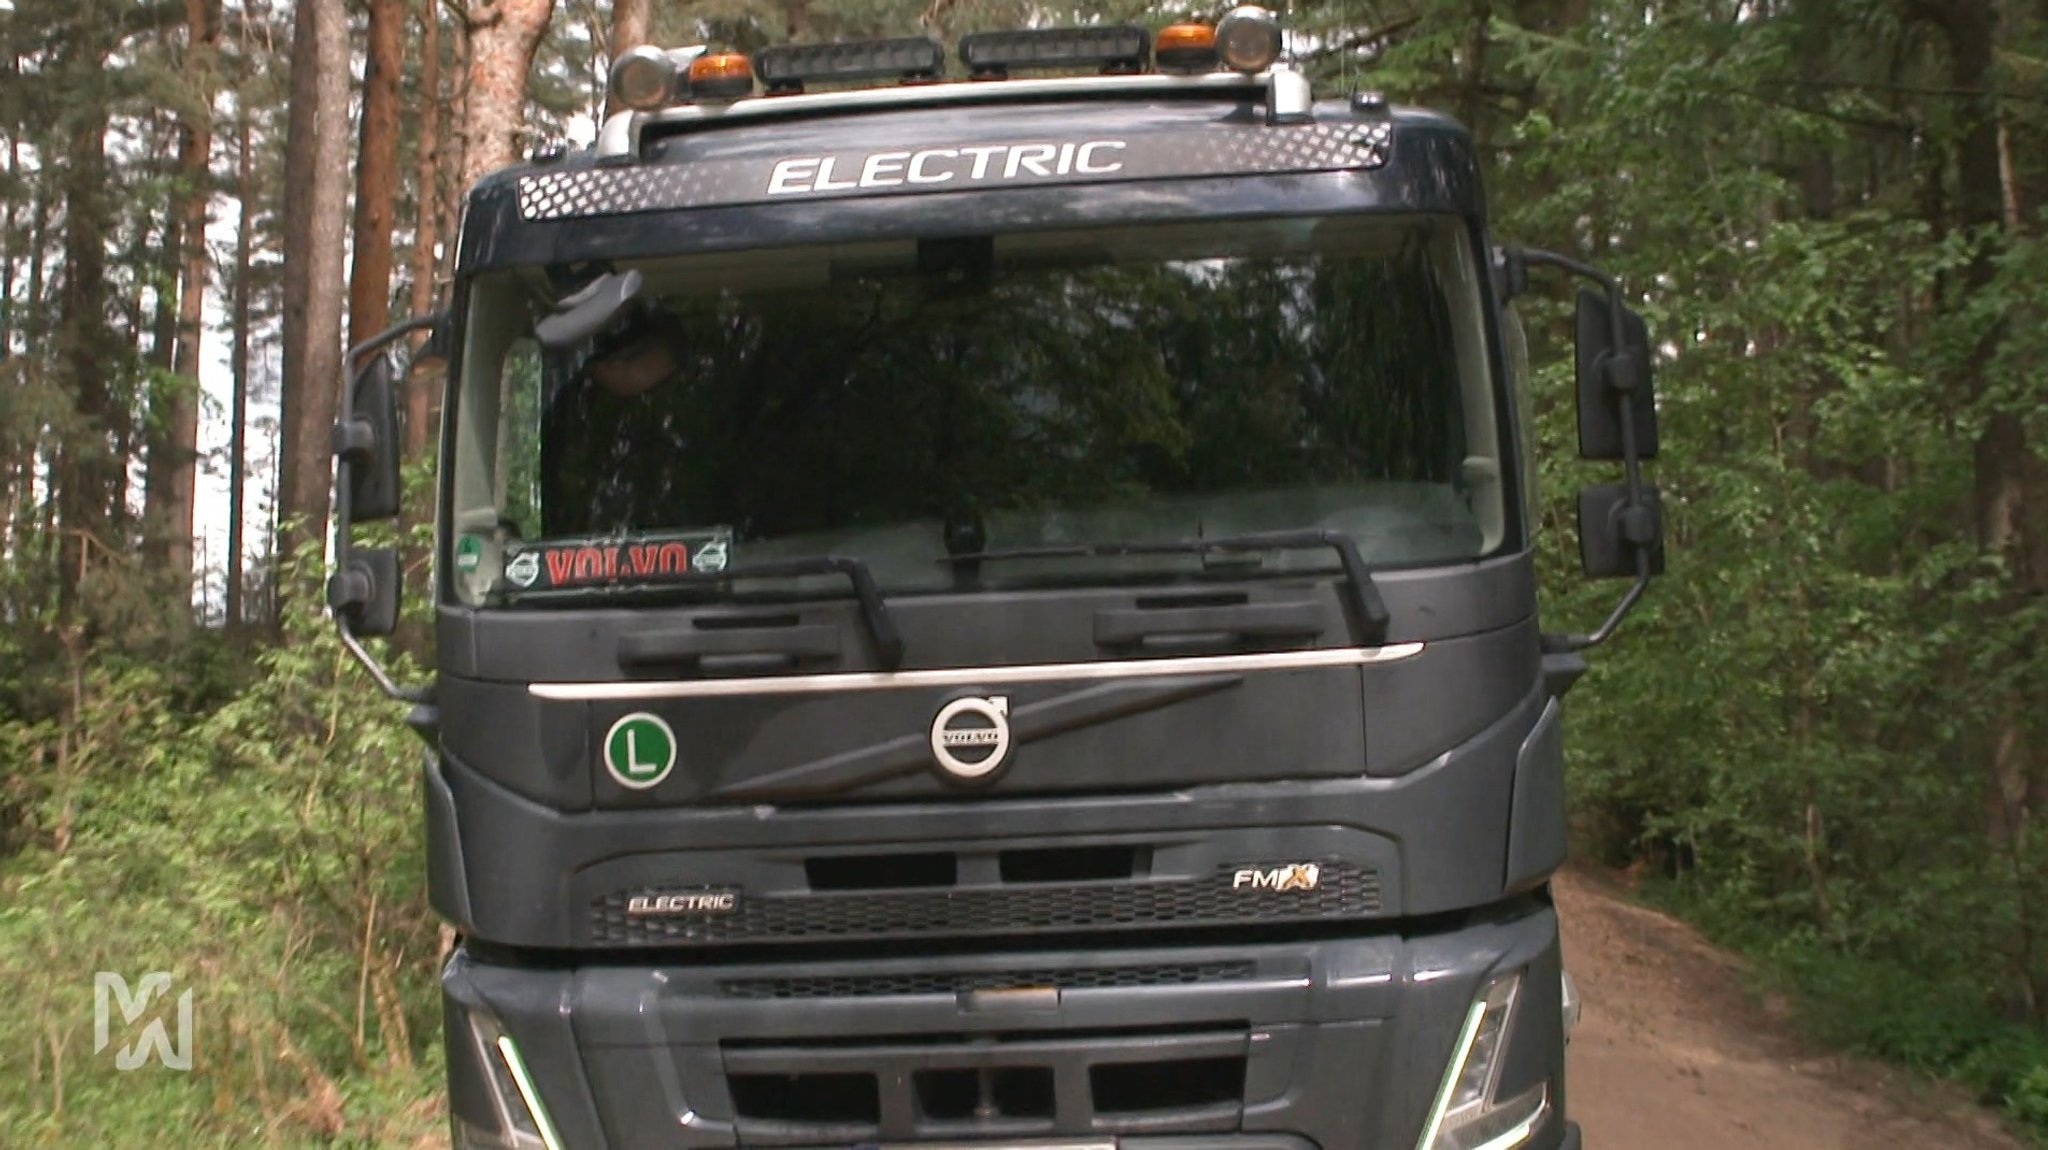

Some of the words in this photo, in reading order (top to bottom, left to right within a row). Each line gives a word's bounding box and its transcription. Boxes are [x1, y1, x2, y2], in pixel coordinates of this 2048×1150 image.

[766, 140, 1127, 196] ELECTRIC
[627, 728, 658, 773] L
[1231, 863, 1320, 892] FMX
[627, 893, 735, 913] ELECTRIC
